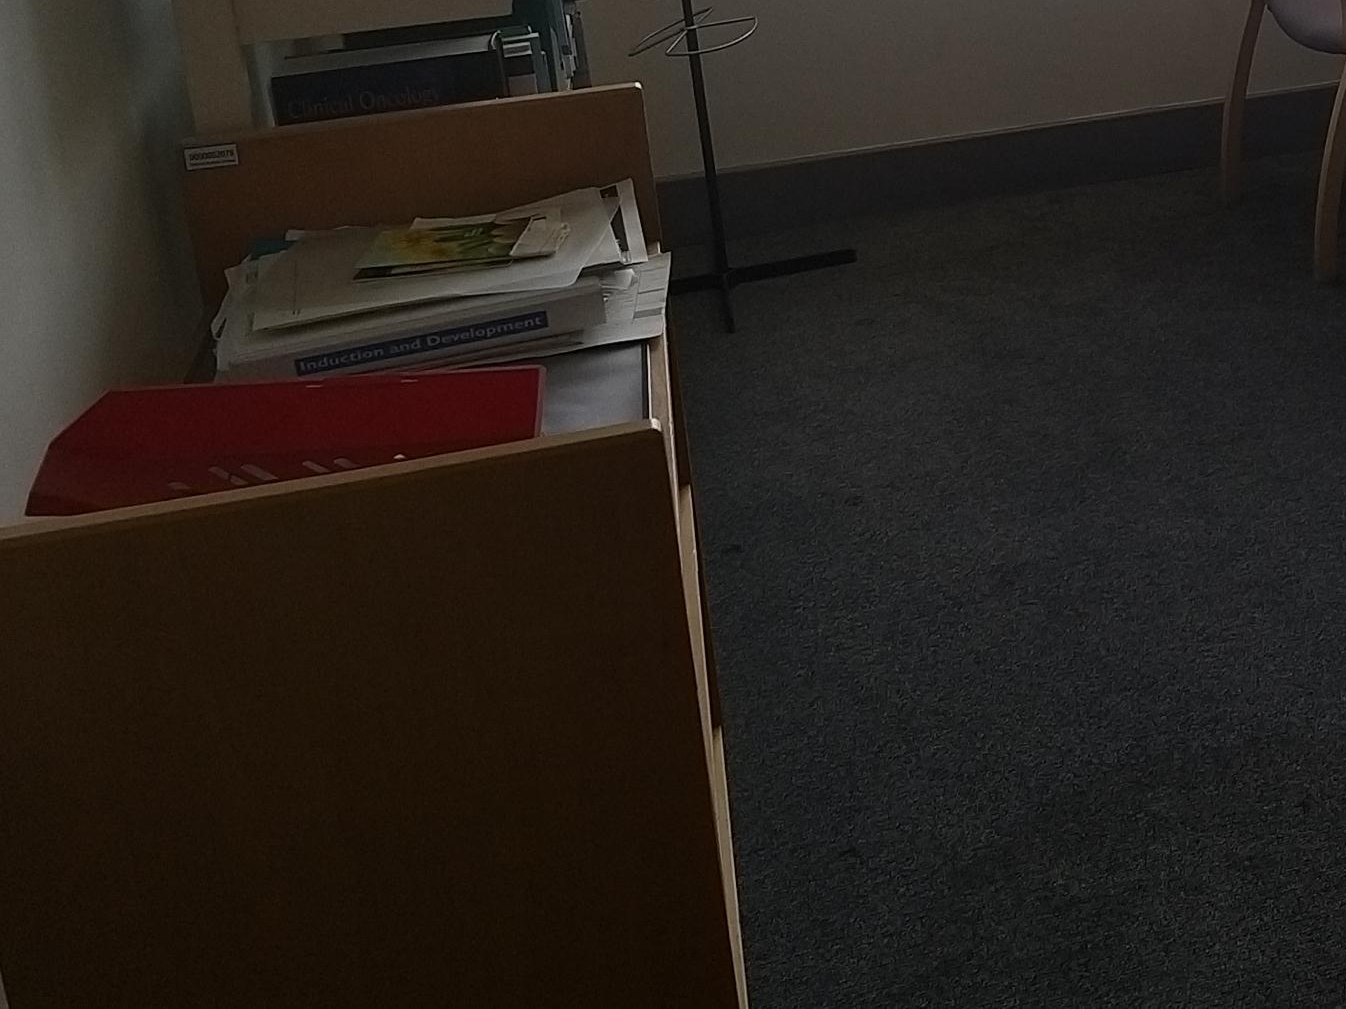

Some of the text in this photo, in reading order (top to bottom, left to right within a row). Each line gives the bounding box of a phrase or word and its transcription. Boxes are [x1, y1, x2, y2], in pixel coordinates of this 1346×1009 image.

[287, 88, 440, 118] Clinical Oncology
[299, 315, 545, 372] Induction and Development
